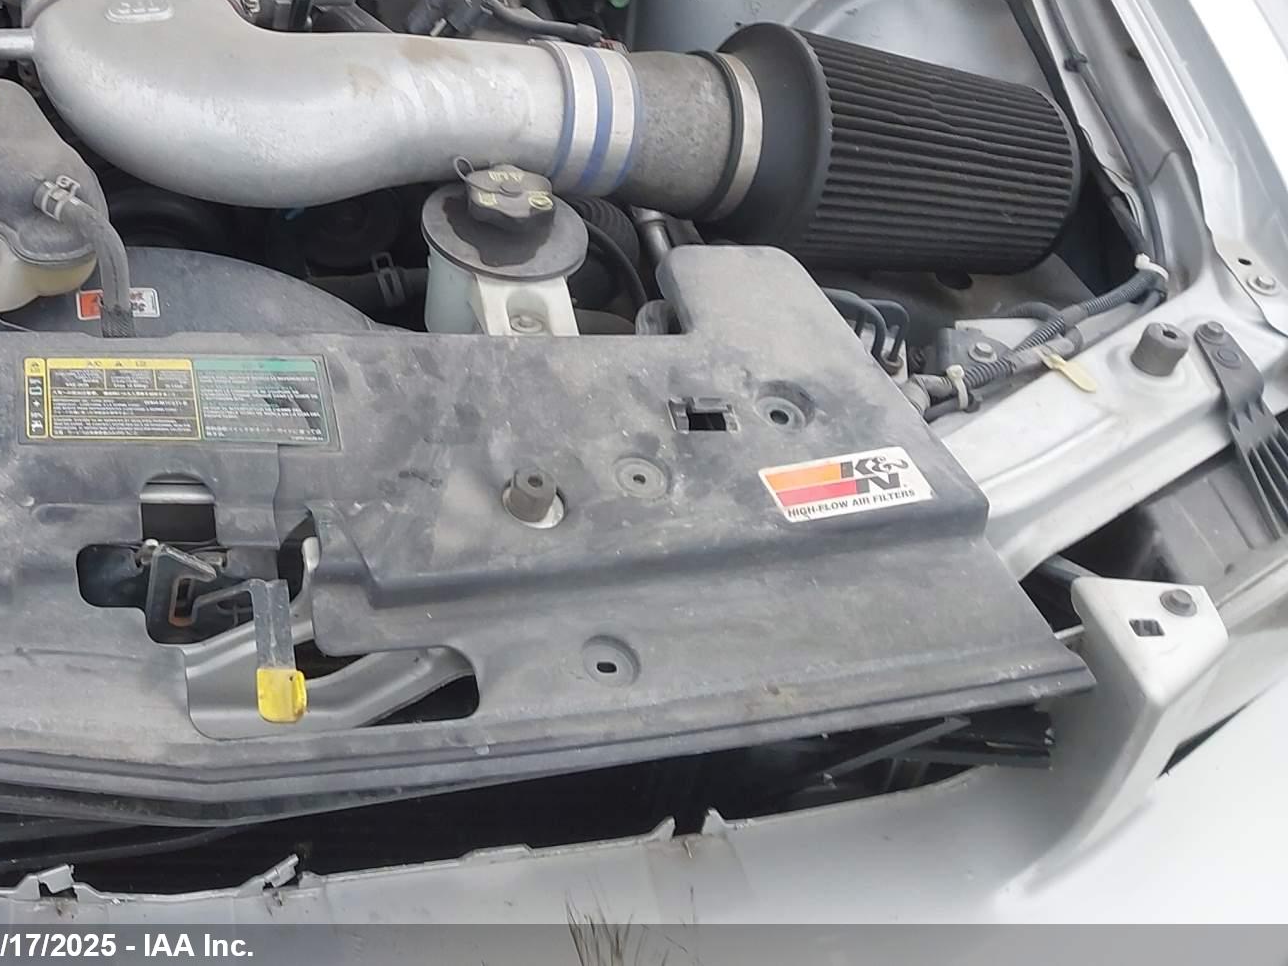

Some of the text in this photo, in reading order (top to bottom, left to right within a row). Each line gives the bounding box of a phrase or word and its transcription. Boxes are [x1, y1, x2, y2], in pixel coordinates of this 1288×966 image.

[787, 490, 916, 518] HIGH-FLOW AIR FILTERS
